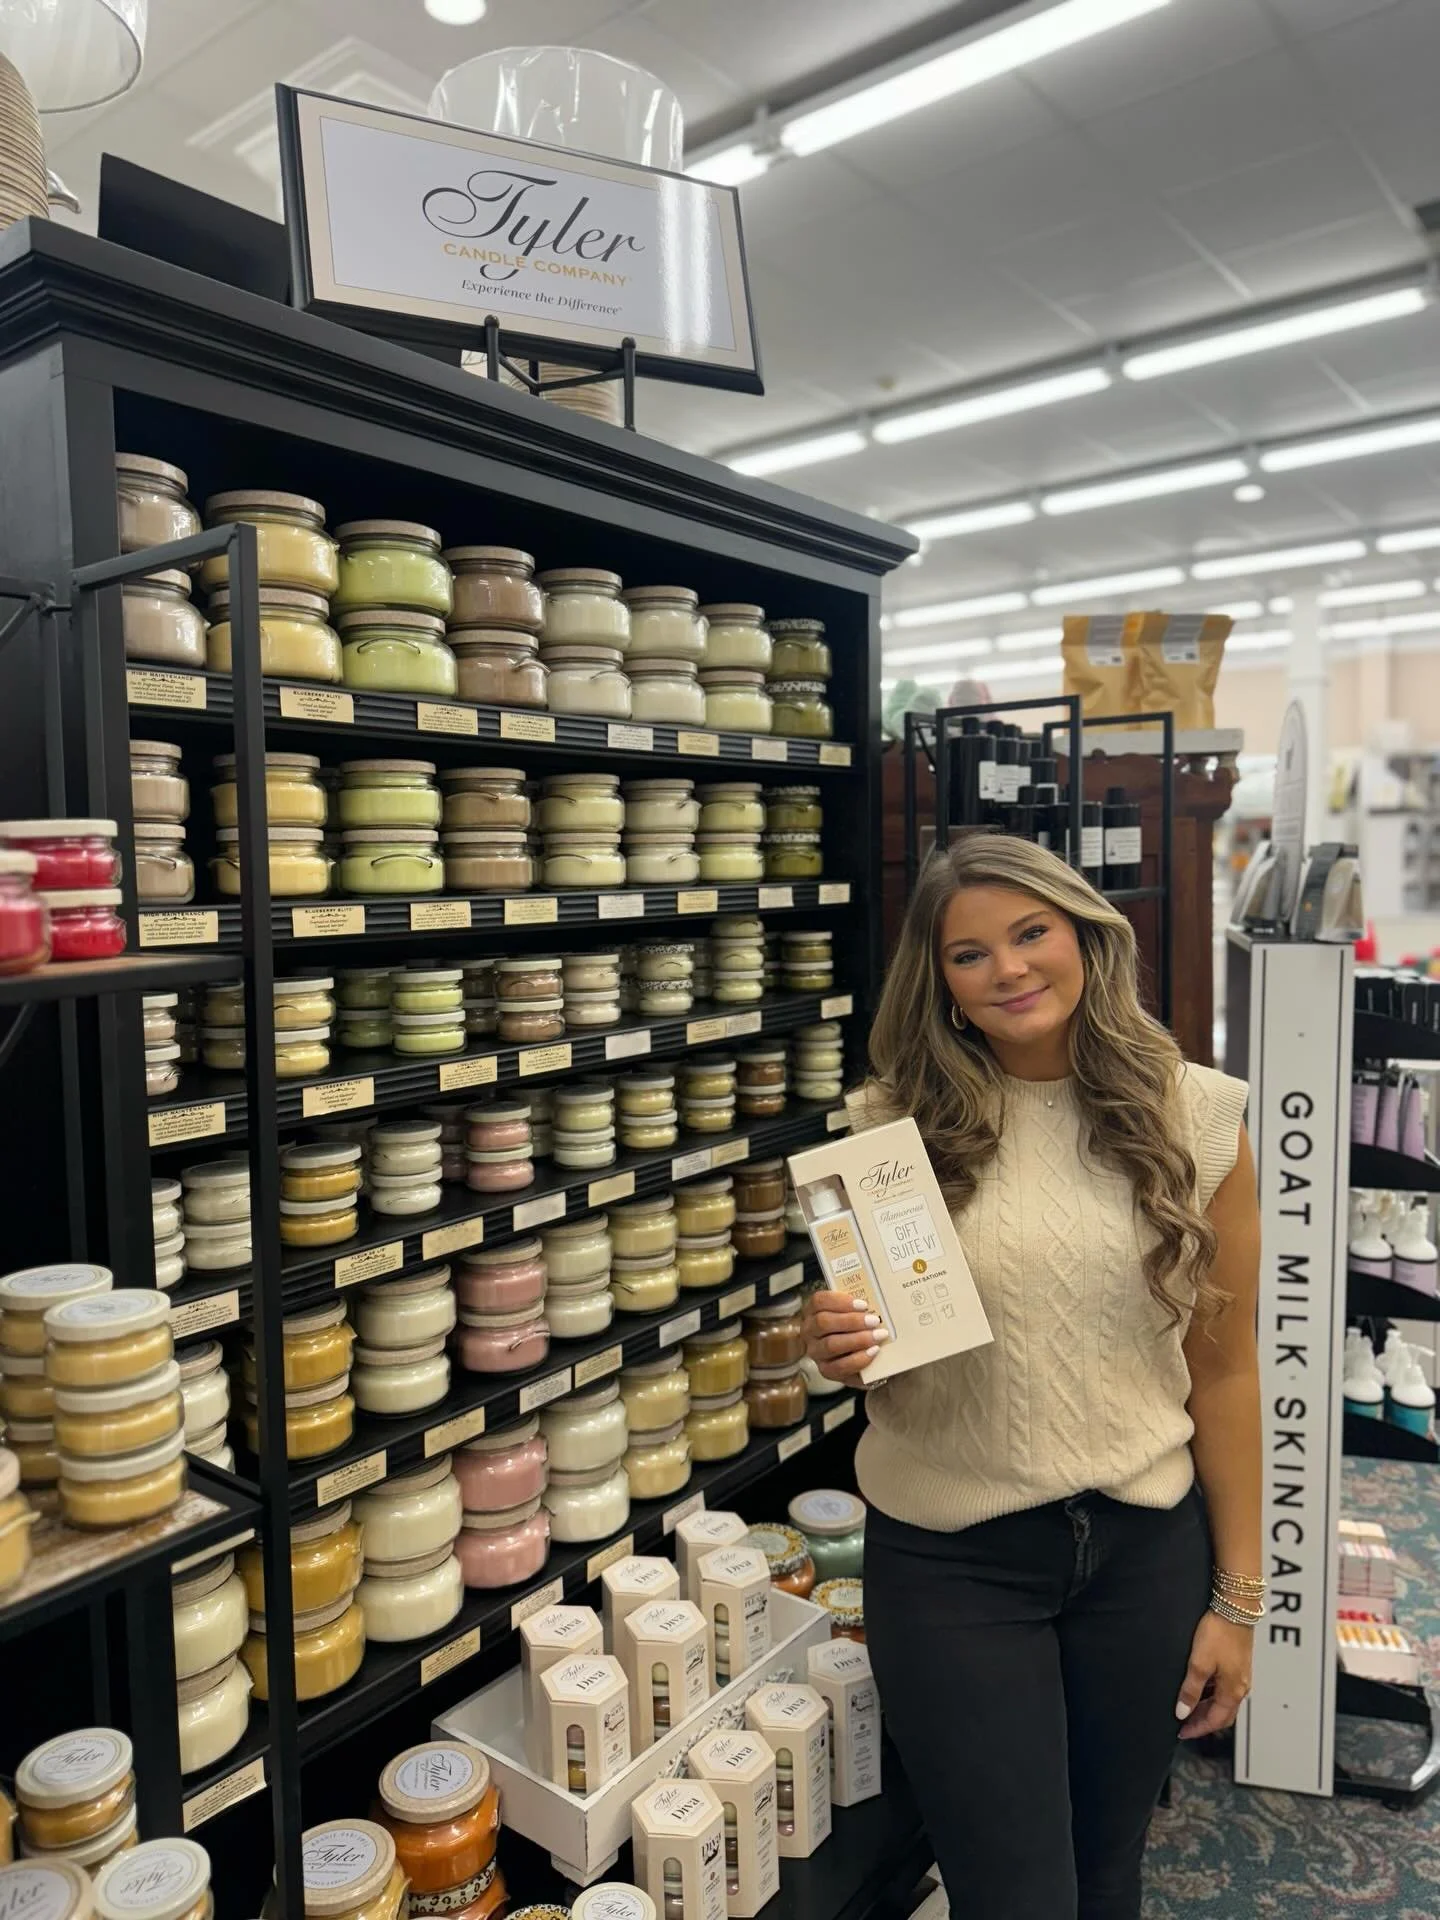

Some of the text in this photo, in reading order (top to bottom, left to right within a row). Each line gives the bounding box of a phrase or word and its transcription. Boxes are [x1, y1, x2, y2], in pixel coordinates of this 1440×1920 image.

[422, 170, 646, 281] Tyler
[443, 243, 628, 287] CANDLE COMPANY
[461, 279, 532, 302] Experience
[535, 291, 556, 305] the
[859, 1160, 915, 1197] Tyler
[894, 1221, 919, 1241] GIFT
[890, 1238, 925, 1261] SUITE
[1269, 1091, 1314, 1648] GOAT MILK SKINCARE
[635, 1568, 661, 1584] Diva
[725, 1559, 752, 1575] Diva
[554, 1618, 584, 1636] Diva
[659, 1613, 687, 1631] Diva
[560, 1663, 587, 1681] Tyler
[834, 1655, 863, 1670] Diva
[576, 1669, 607, 1691] Diva
[781, 1697, 808, 1716] Diva
[725, 1746, 753, 1767] Diva
[421, 1753, 452, 1792] Tyler
[654, 1788, 679, 1811] Tyler
[670, 1796, 701, 1820] Diva
[304, 1844, 365, 1870] Tyler
